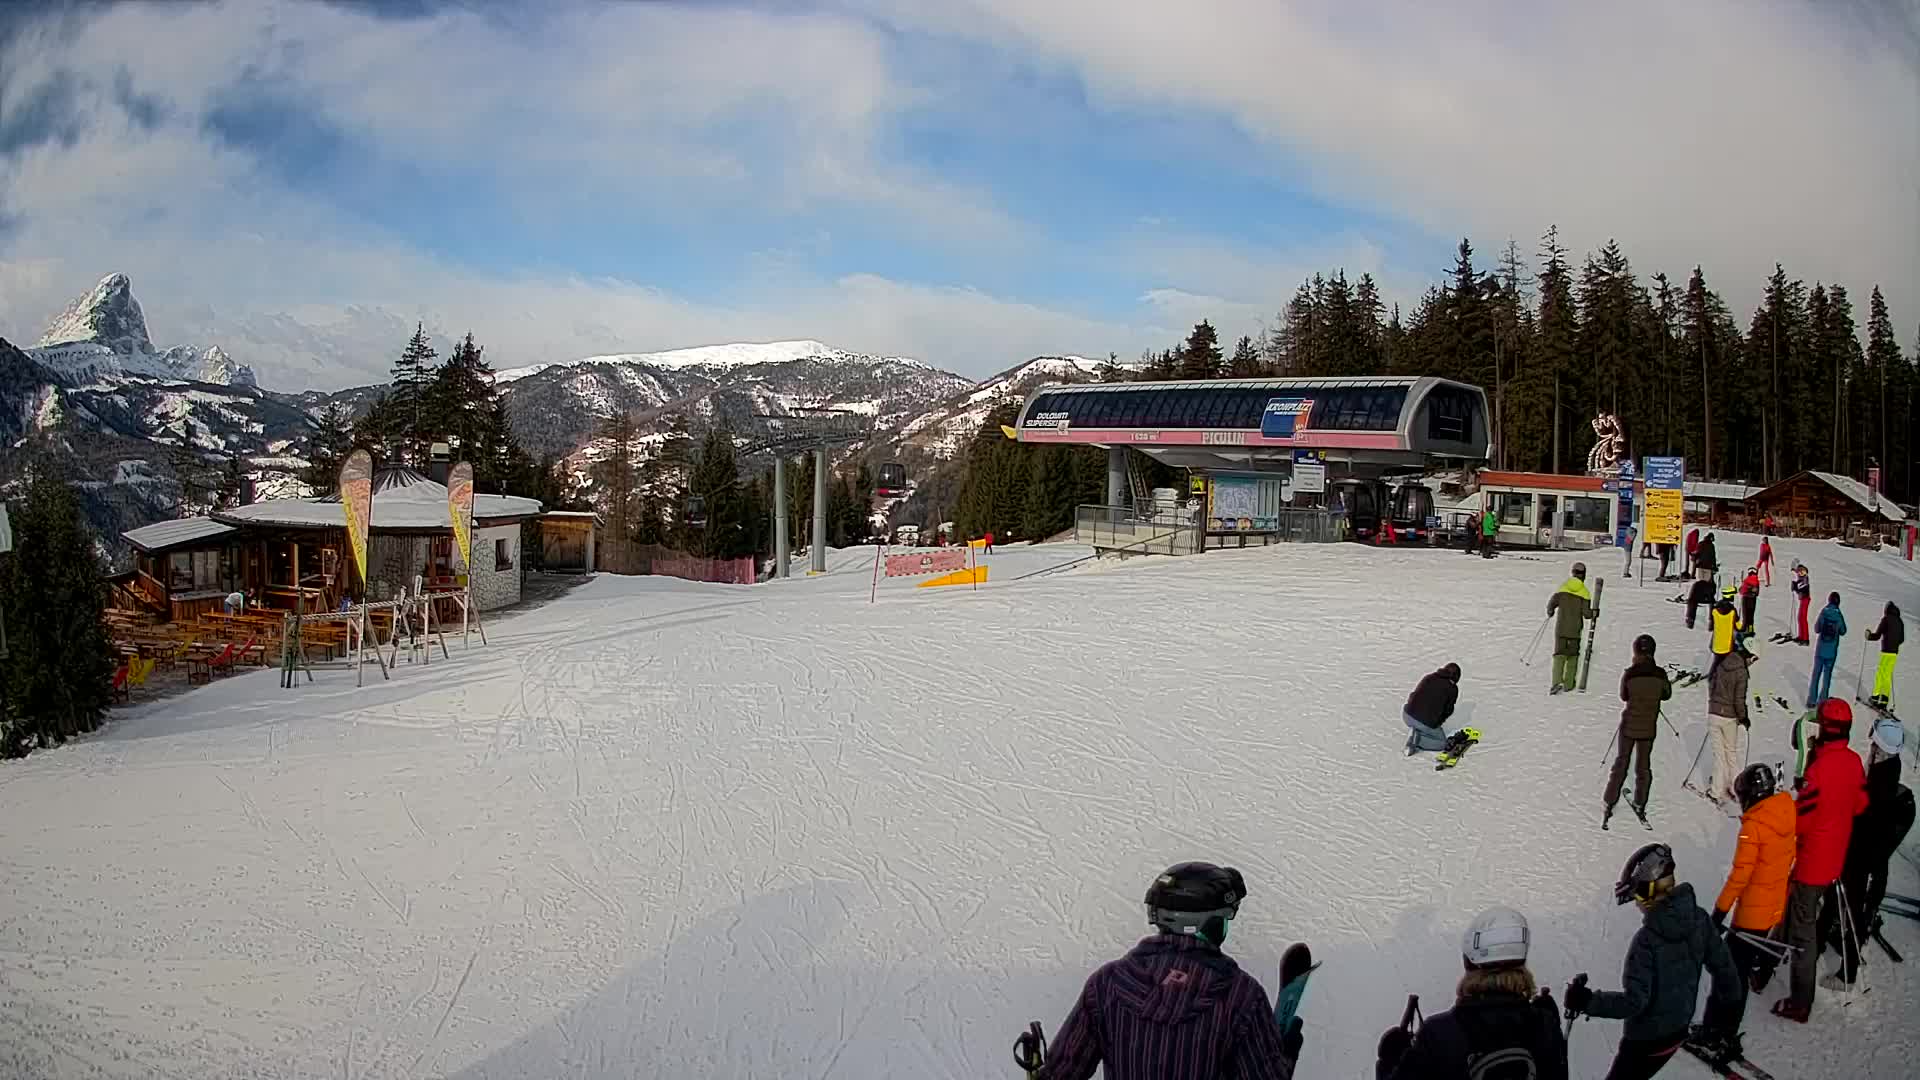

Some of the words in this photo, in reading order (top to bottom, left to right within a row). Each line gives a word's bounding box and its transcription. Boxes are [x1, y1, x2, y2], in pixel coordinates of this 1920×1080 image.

[1266, 403, 1311, 411] KRONPLATZ
[1036, 412, 1069, 420] DOLOMITI
[1025, 419, 1058, 427] SUPERSKI
[1202, 432, 1245, 445] PICULIN
